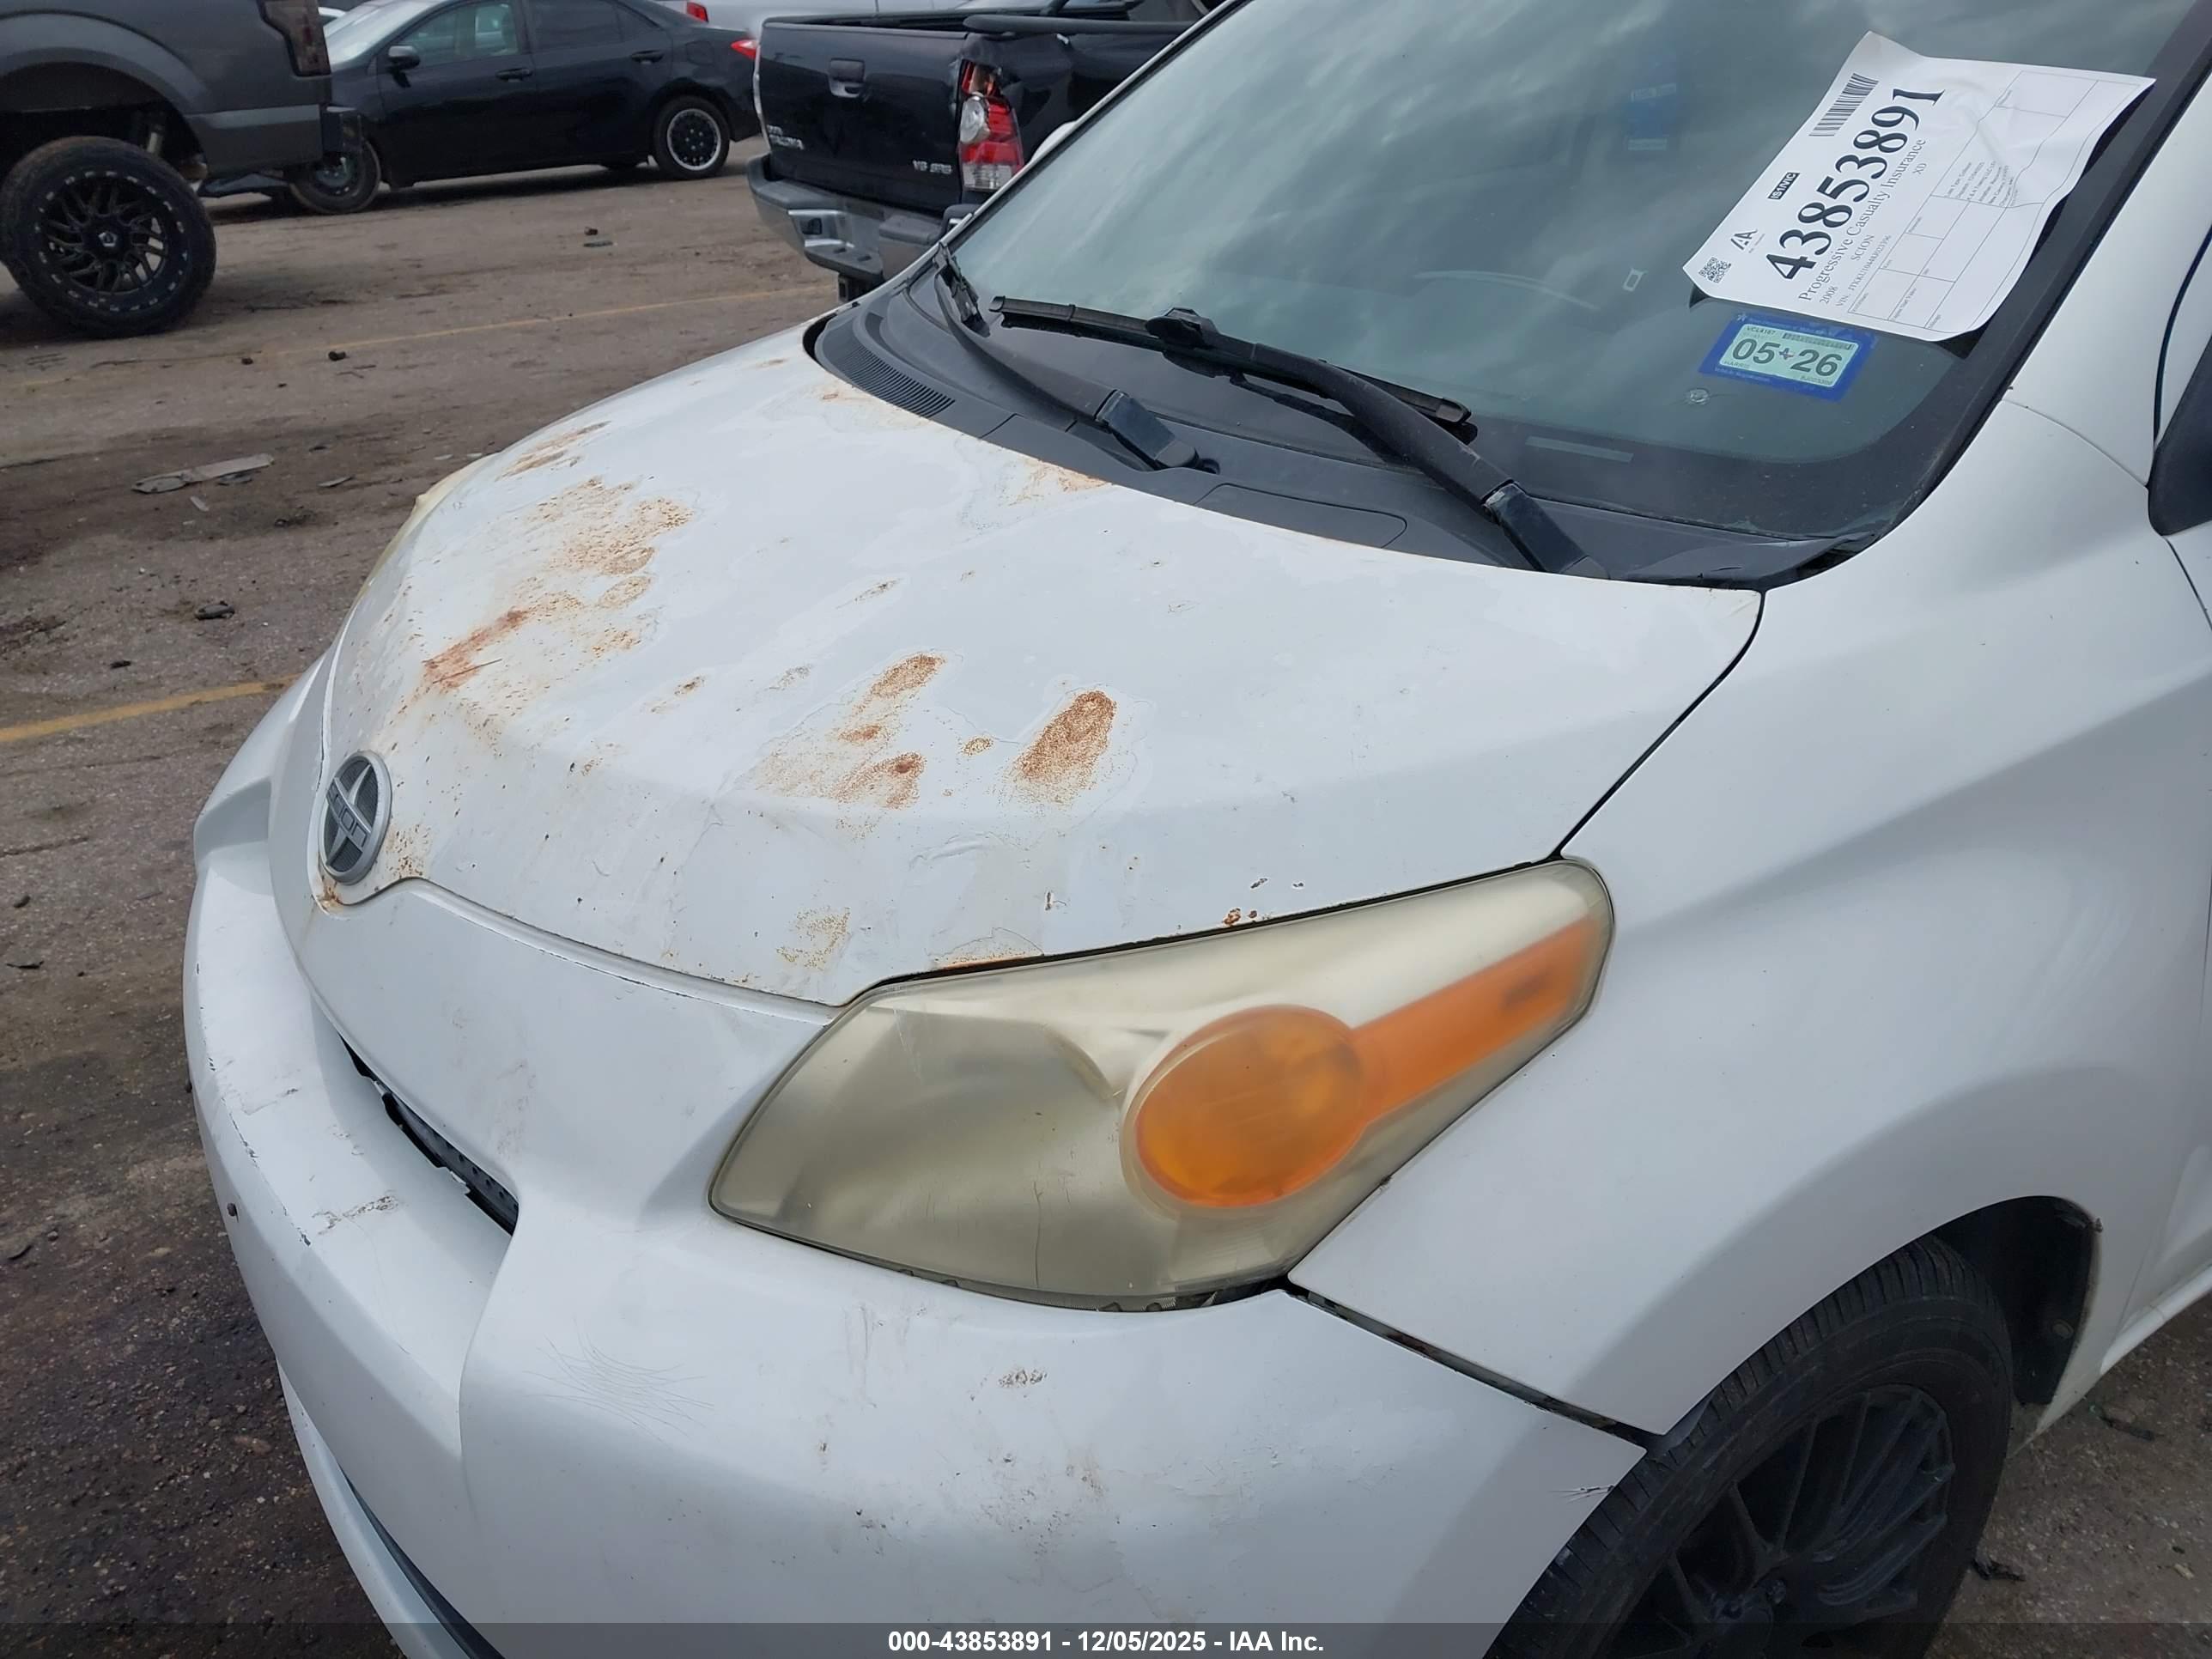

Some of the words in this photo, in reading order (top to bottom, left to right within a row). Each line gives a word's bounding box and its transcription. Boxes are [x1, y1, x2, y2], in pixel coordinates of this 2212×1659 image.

[1766, 88, 1946, 280] 43853891
[1798, 238, 1853, 301] Progressive
[1846, 191, 1890, 236] Casualty
[1881, 138, 1926, 188] Insurance
[1820, 286, 1838, 305] 2008
[1850, 234, 1875, 261] SCION
[1733, 338, 1781, 364] 05
[1790, 349, 1843, 377] 26
